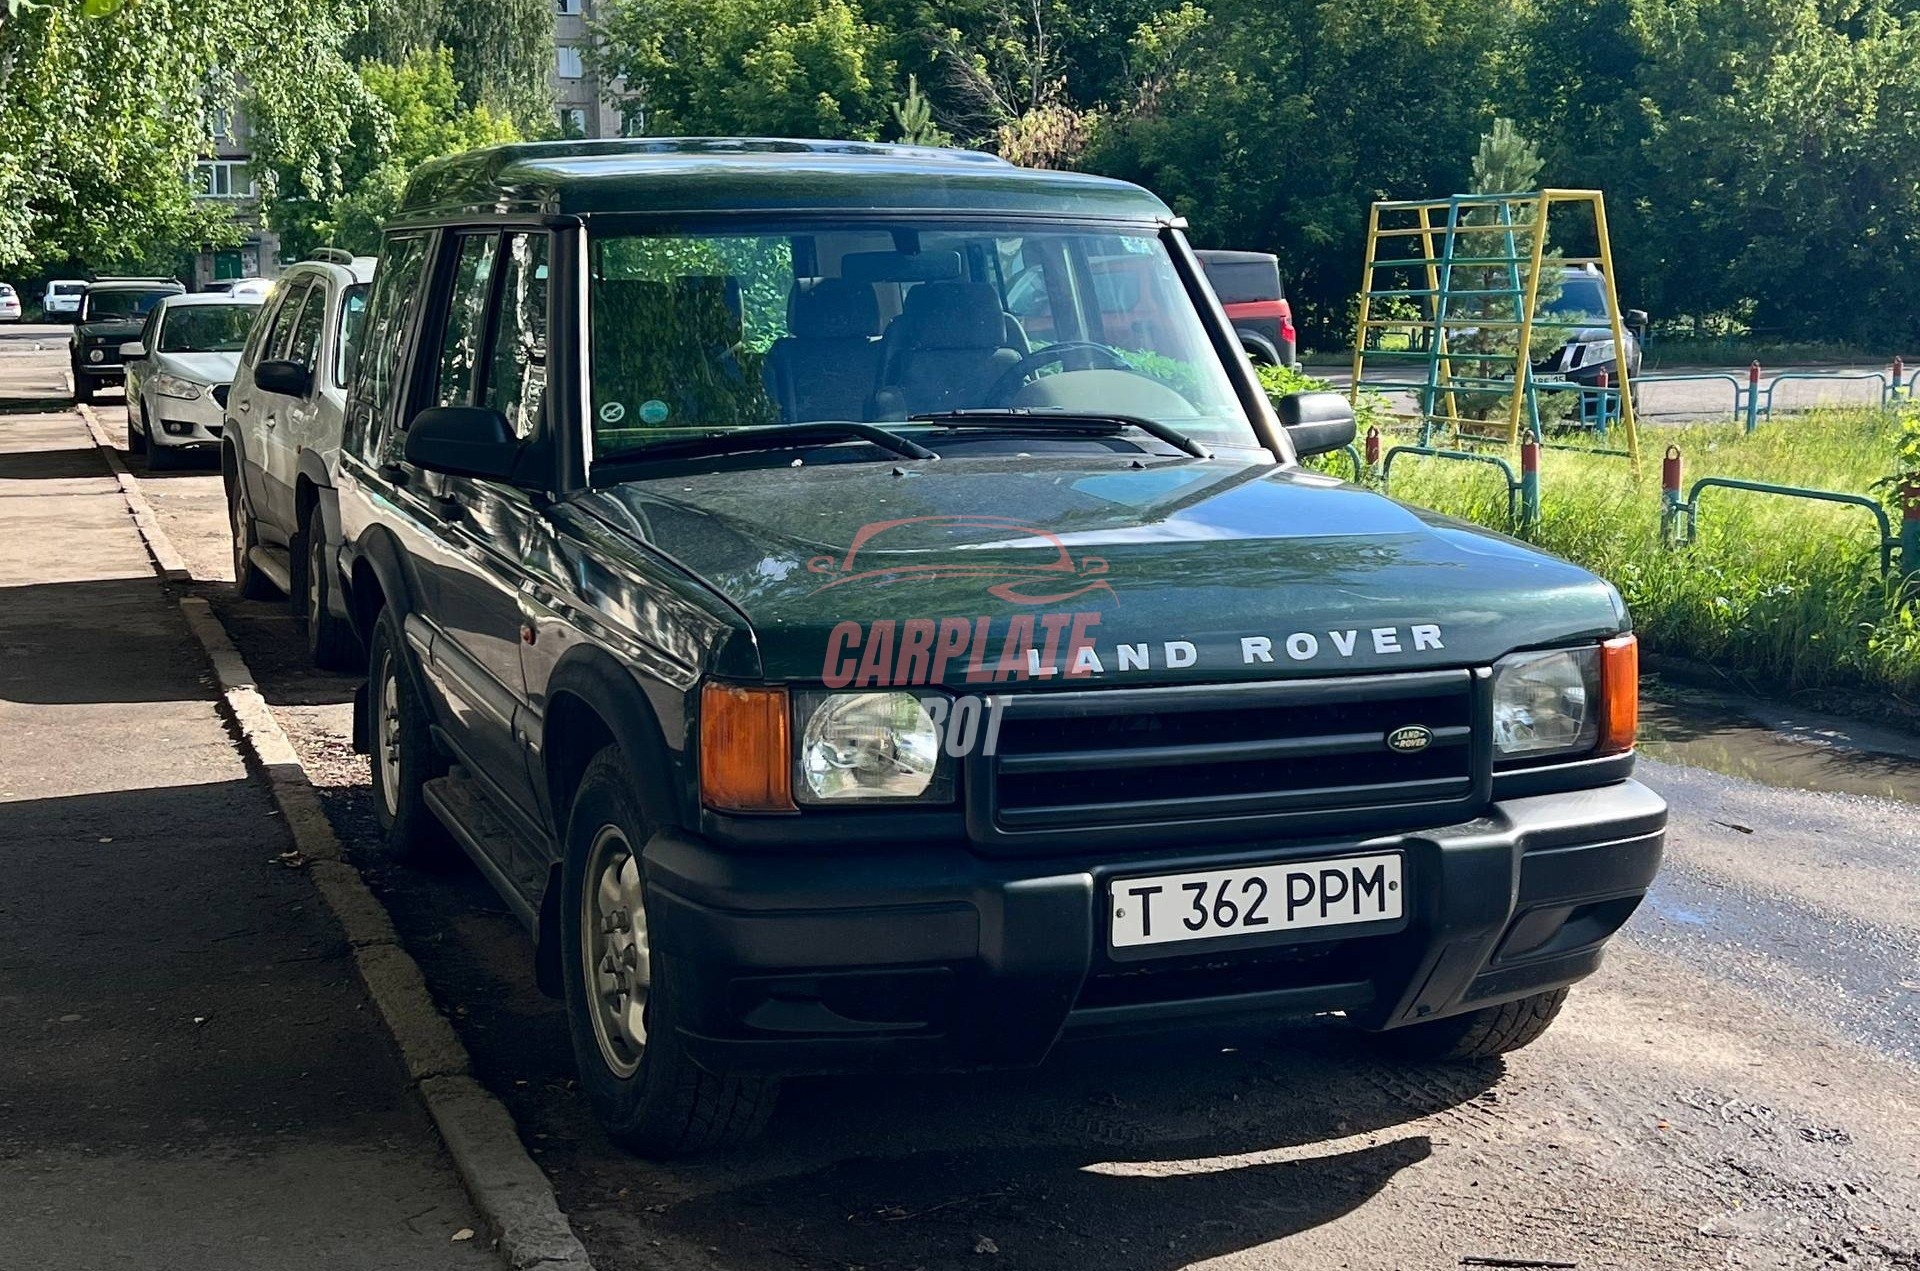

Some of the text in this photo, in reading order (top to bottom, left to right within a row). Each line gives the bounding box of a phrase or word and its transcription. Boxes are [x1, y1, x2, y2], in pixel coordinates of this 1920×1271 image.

[1027, 624, 1446, 676] LAND ROVER
[1128, 864, 1386, 937] T 362 PPM
